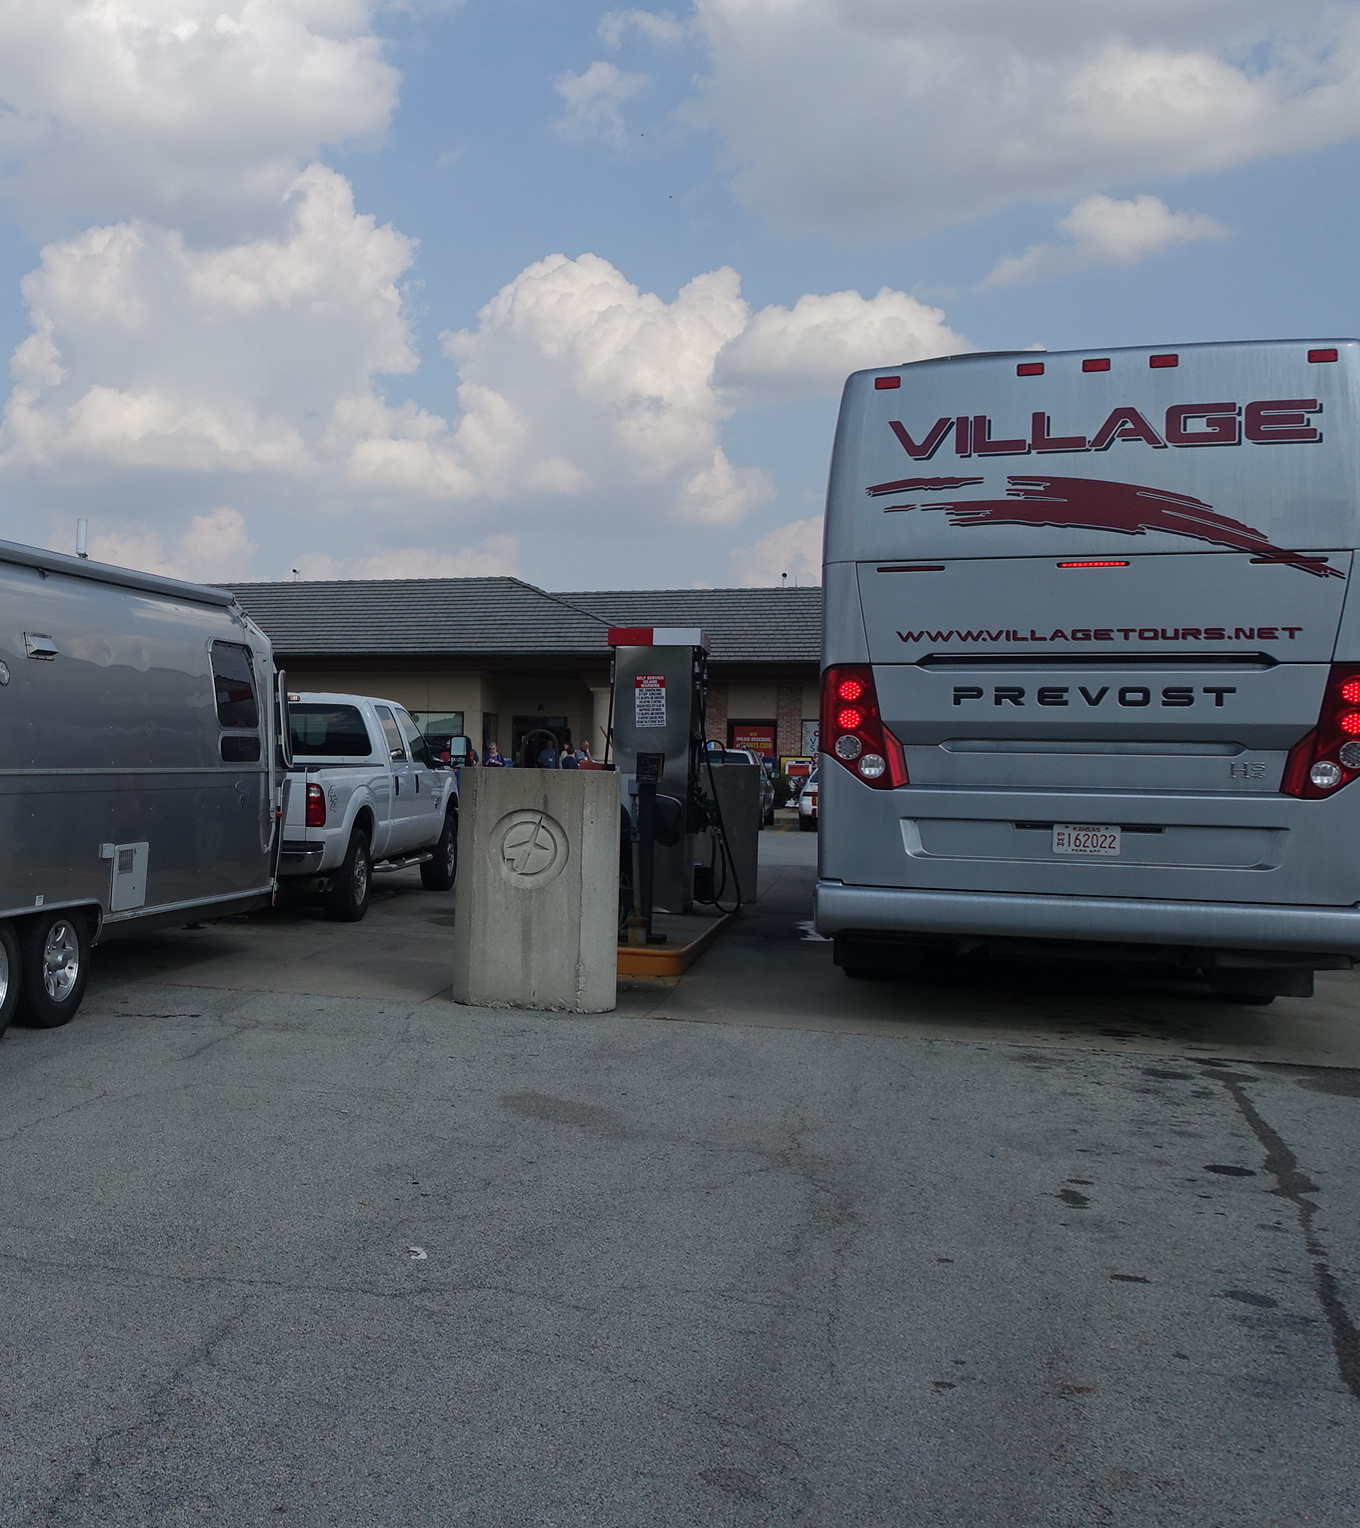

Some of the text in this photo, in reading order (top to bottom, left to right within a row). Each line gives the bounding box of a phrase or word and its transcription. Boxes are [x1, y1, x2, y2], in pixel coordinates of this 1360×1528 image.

[888, 398, 1323, 461] VILLAGE
[896, 627, 1303, 643] WWW.VILLAGETOURS.NET
[952, 685, 1237, 707] PREVOST
[1068, 833, 1117, 849] 162022
